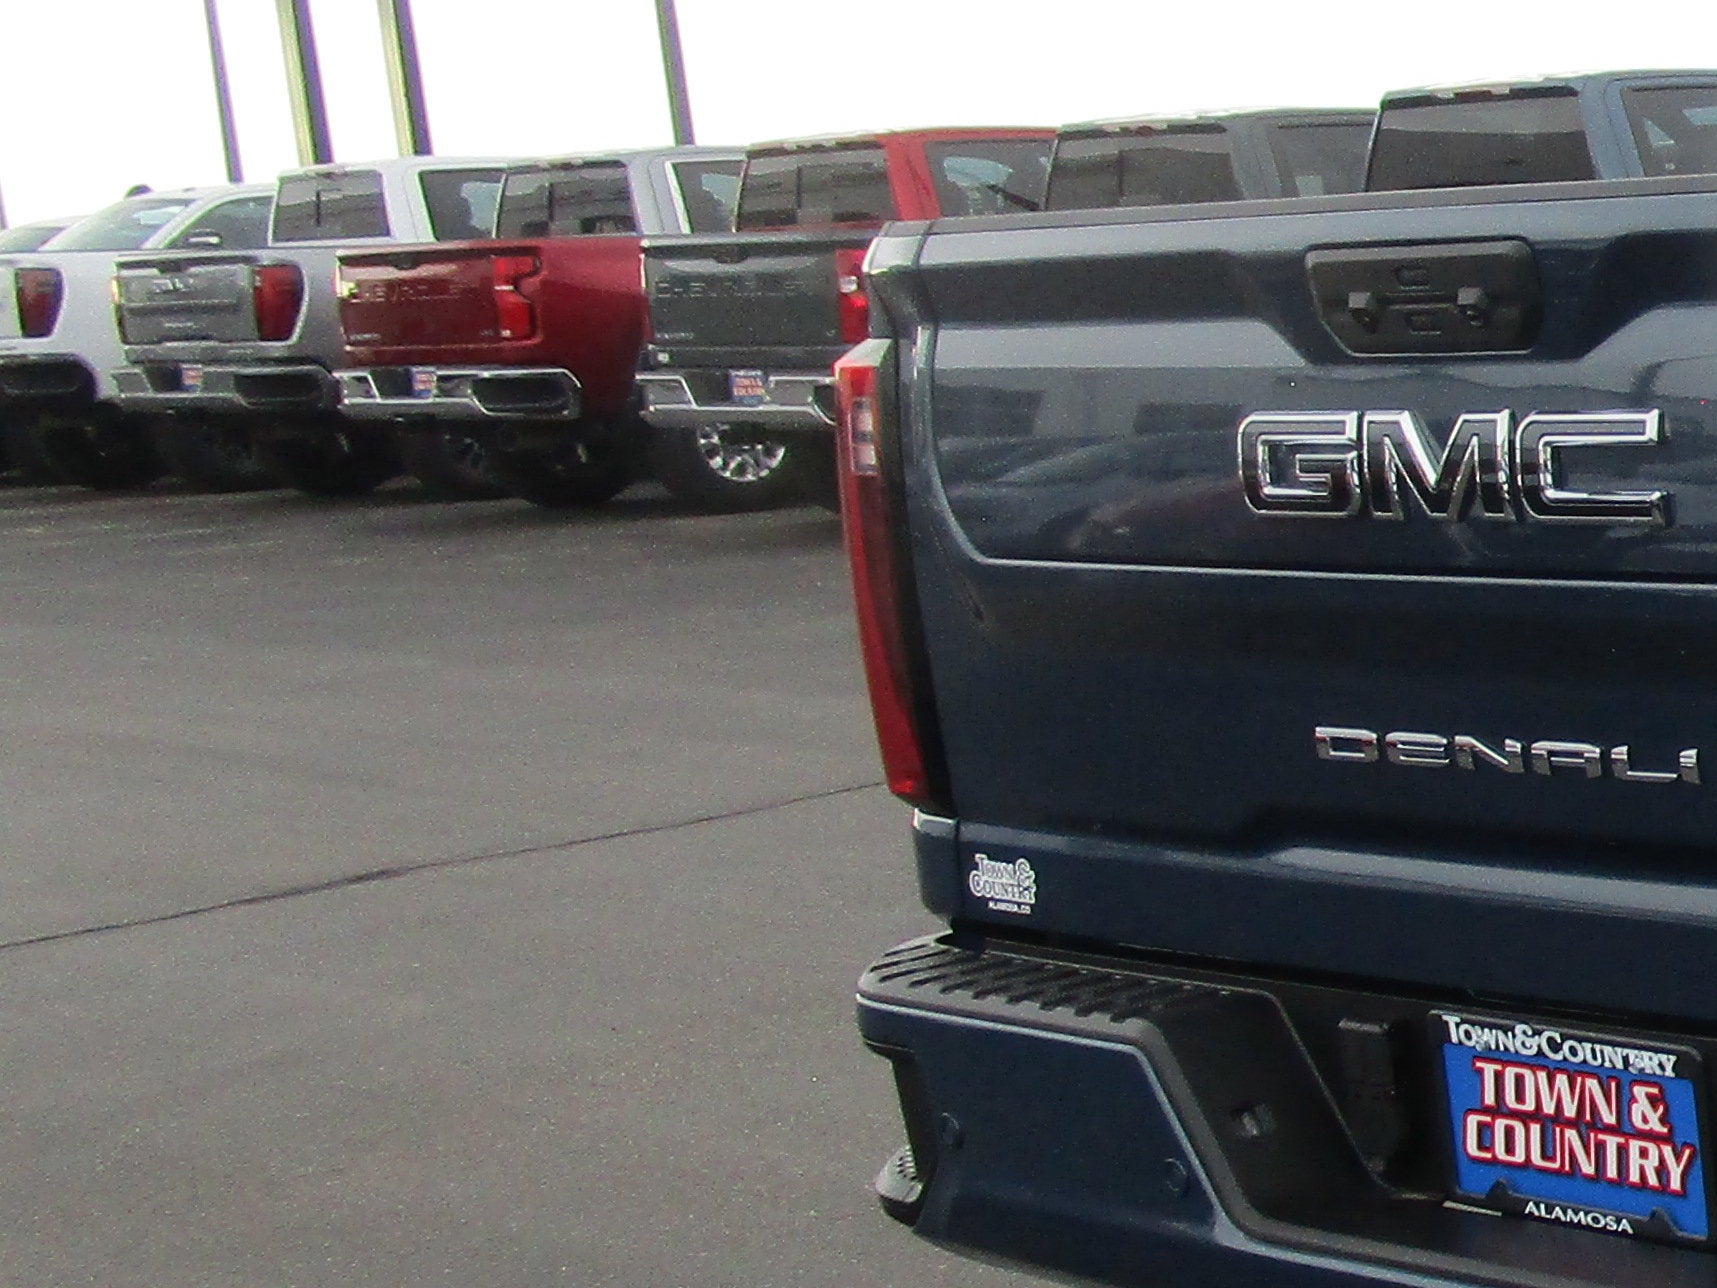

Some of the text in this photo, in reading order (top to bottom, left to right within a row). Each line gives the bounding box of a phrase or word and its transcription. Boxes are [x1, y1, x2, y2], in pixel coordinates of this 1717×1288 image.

[1236, 409, 1671, 526] GMC
[1314, 725, 1701, 784] DENALI
[1472, 1057, 1671, 1136] TOWN &
[1463, 1110, 1695, 1194] COUNTRY
[1523, 1200, 1635, 1235] ALAMOSA
